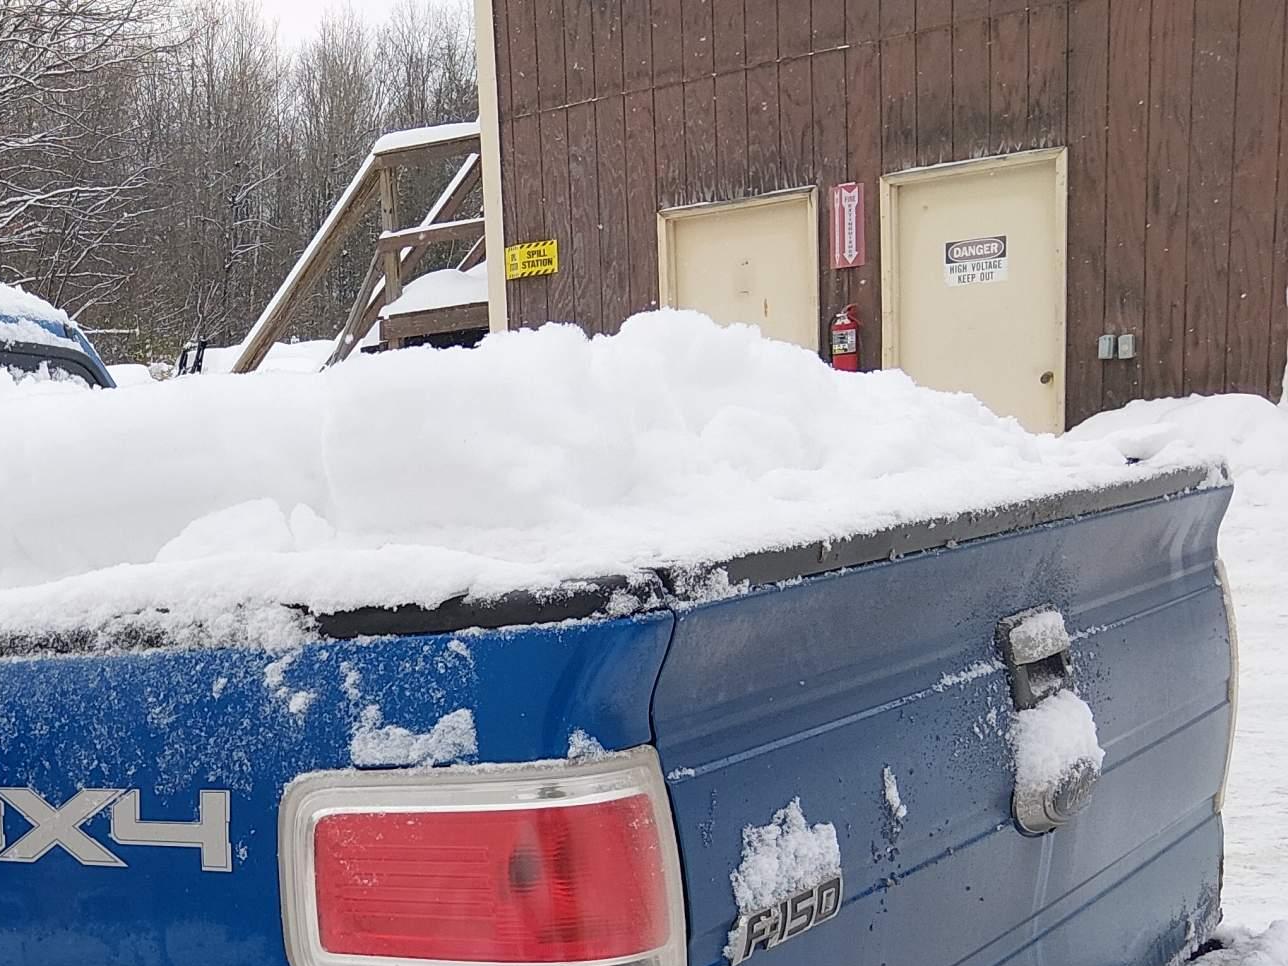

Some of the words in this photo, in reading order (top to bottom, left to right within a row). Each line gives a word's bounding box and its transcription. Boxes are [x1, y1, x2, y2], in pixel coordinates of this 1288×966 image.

[526, 248, 548, 260] SPILL
[953, 242, 999, 259] DANGER
[521, 257, 553, 270] STATION
[949, 263, 968, 275] HIGH
[971, 259, 1003, 273] VOLTAGE
[957, 273, 976, 284] KEEP
[979, 271, 994, 282] OUT
